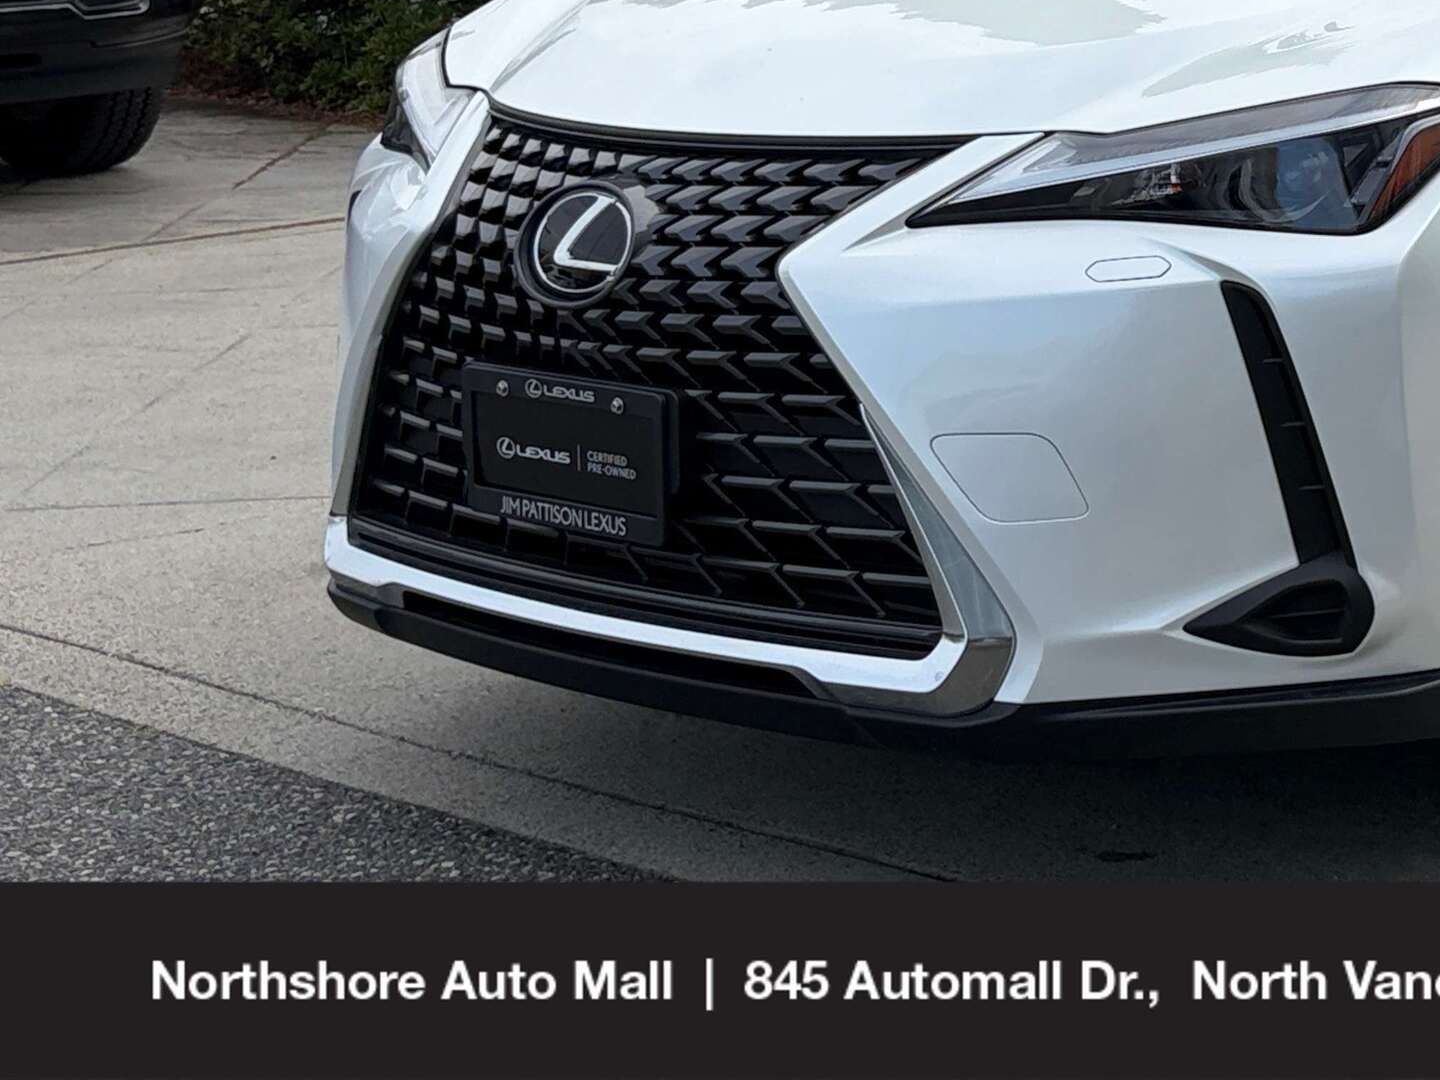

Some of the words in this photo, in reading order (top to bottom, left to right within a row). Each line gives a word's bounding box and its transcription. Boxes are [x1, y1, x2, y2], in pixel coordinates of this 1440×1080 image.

[542, 384, 595, 403] LEXUS
[516, 443, 571, 464] LEXUS
[586, 450, 628, 467] CERTIFIED
[587, 461, 637, 480] PRE-OWNED
[500, 496, 520, 517] JIM
[521, 500, 583, 528] PATTISON
[584, 510, 626, 536] LEXUS
